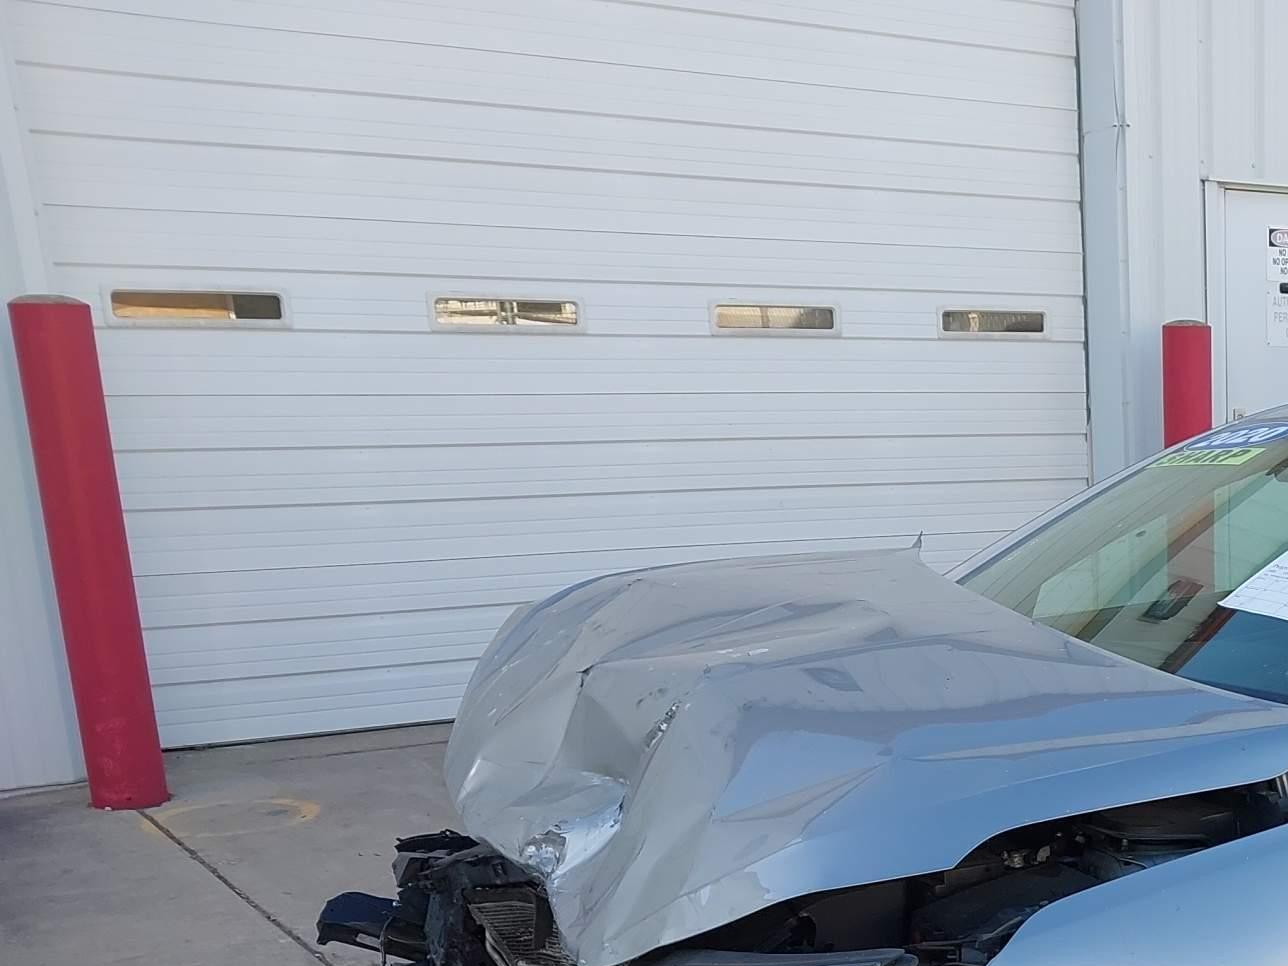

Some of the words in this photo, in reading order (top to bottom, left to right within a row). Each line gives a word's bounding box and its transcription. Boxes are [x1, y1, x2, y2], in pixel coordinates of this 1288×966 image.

[1279, 249, 1287, 257] NO
[1272, 257, 1280, 266] NO
[1280, 267, 1288, 275] NO
[1156, 448, 1253, 464] SHARP
